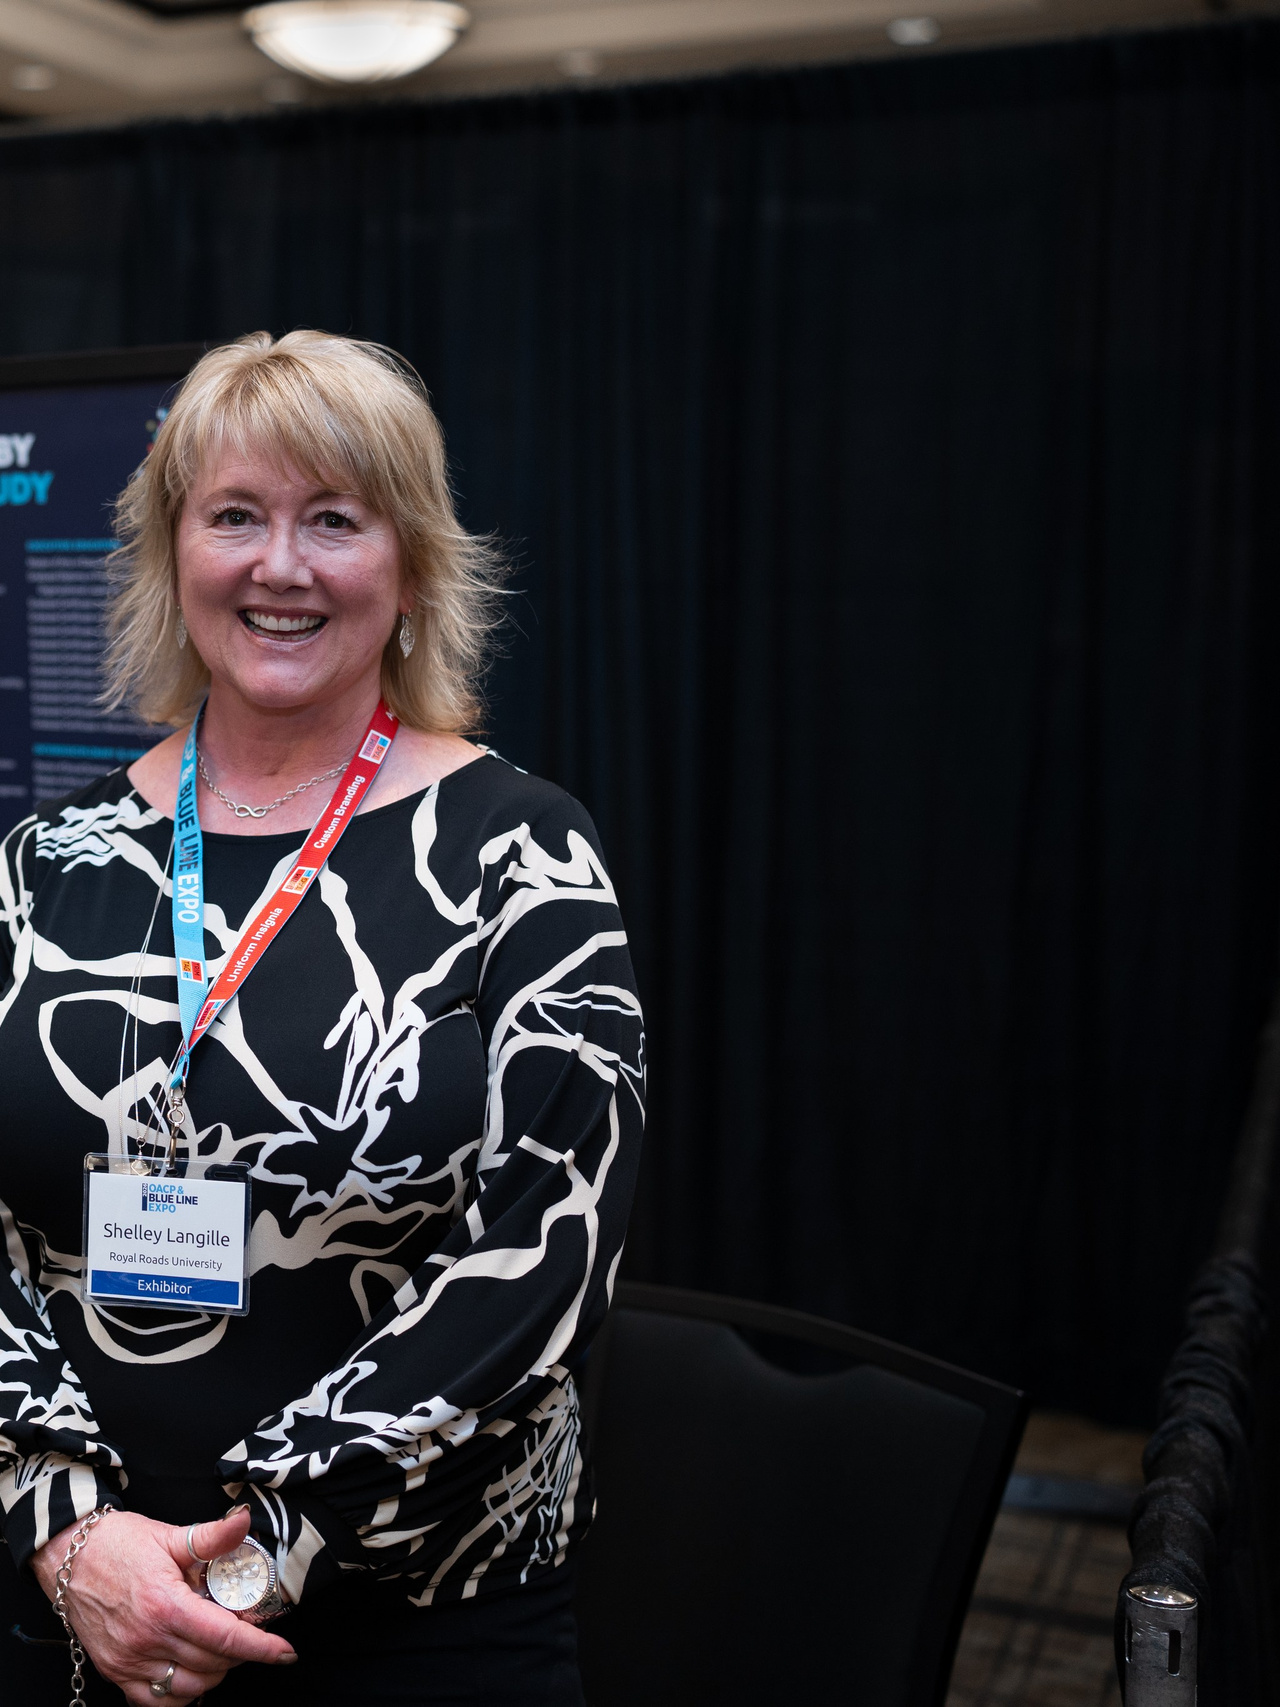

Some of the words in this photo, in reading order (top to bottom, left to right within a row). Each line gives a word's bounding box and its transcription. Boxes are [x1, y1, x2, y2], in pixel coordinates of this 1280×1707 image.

[363, 738, 375, 755] TRIM
[372, 746, 384, 759] TAG
[178, 781, 196, 832] BLUE
[313, 816, 341, 849] Custom
[334, 775, 366, 817] Branding
[179, 832, 199, 872] LINE
[177, 873, 200, 924] EXPO
[226, 942, 258, 982] Uniform
[251, 907, 283, 944] Insignia
[149, 1183, 176, 1194] OACP
[177, 1185, 184, 1194] &
[148, 1193, 174, 1203] BLUE
[176, 1195, 198, 1205] LINE
[148, 1203, 176, 1213] EXPO
[103, 1223, 162, 1245] Shelley
[167, 1228, 230, 1248] Langille
[109, 1251, 137, 1264] Royal
[139, 1253, 169, 1266] Roads
[172, 1257, 222, 1271] University
[137, 1279, 193, 1295] Exhibitor
